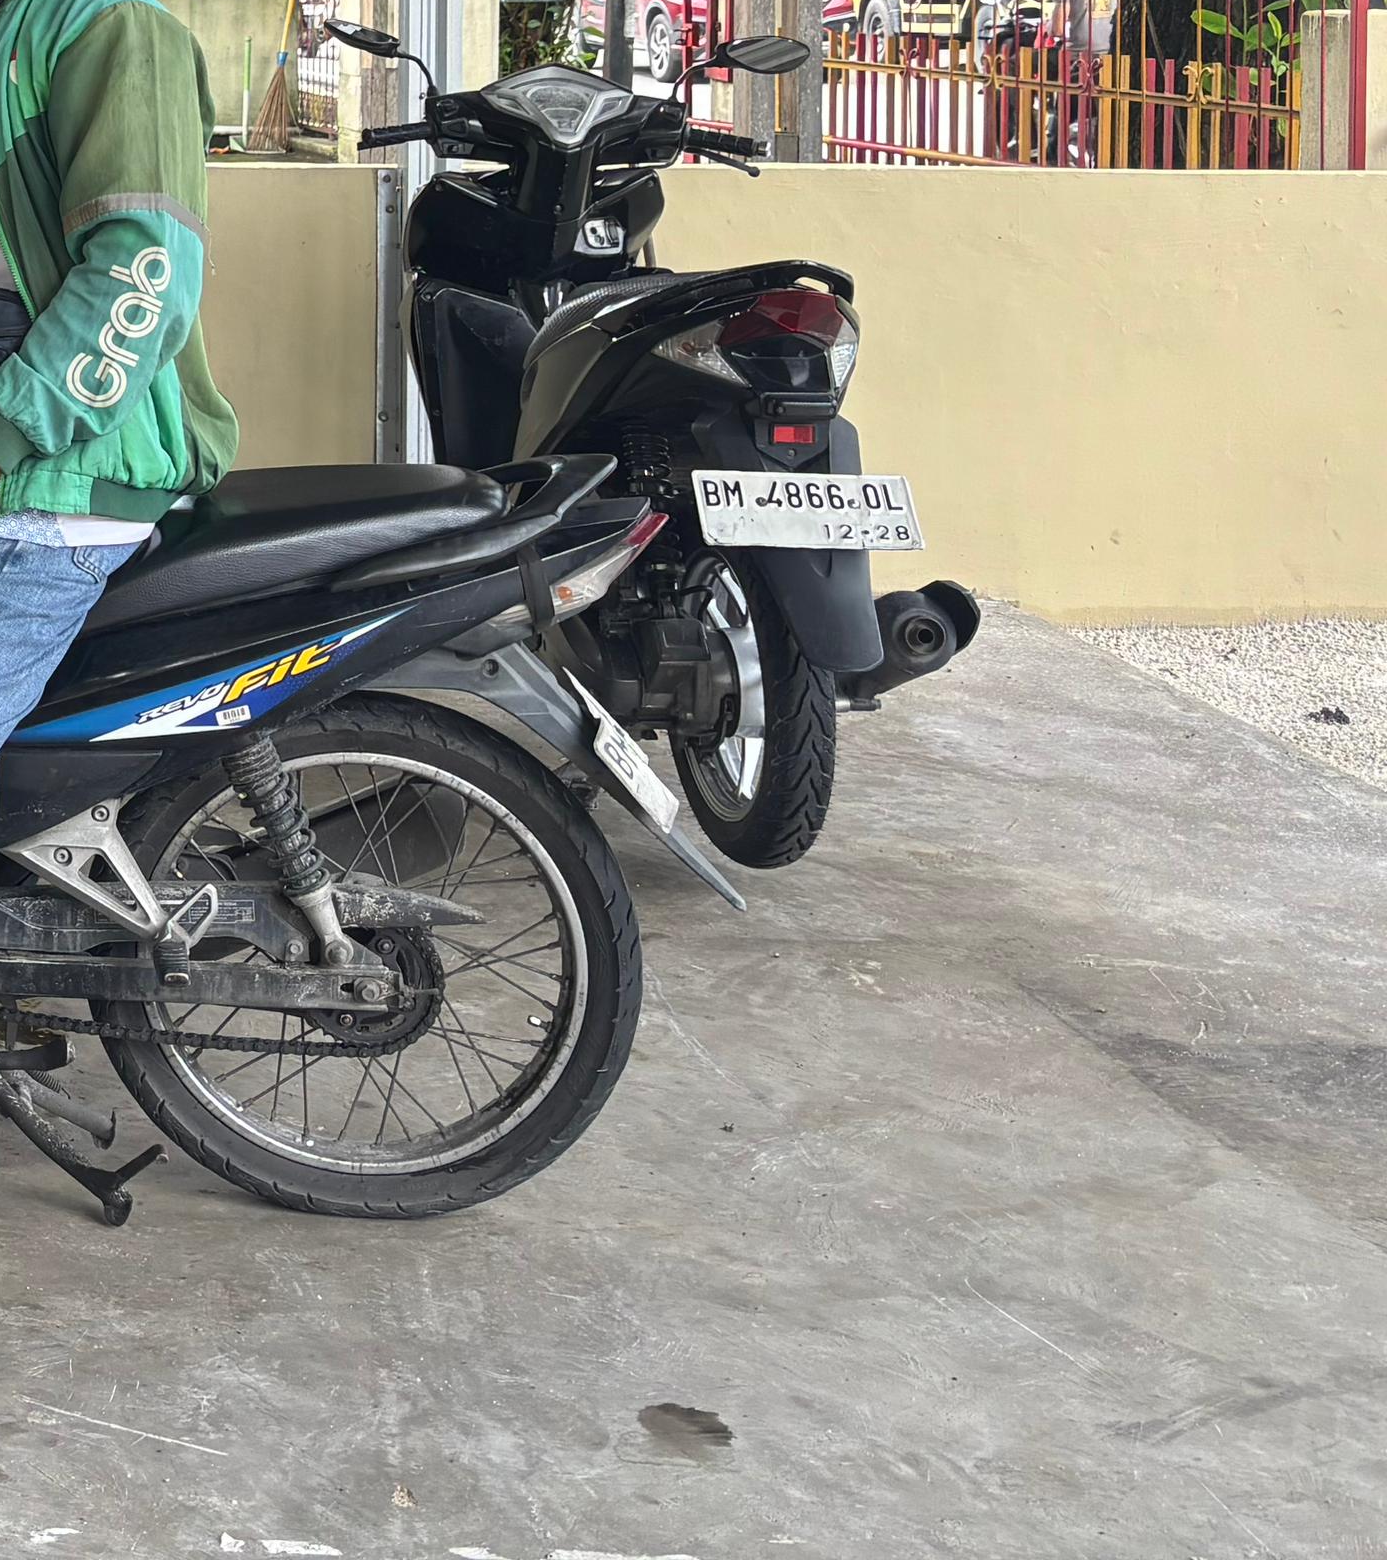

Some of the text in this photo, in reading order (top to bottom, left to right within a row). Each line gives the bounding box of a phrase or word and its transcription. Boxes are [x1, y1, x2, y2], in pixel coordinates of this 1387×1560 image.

[66, 246, 172, 408] Grab
[701, 479, 745, 509] BM
[767, 480, 846, 511] 4866
[136, 682, 228, 724] REVO
